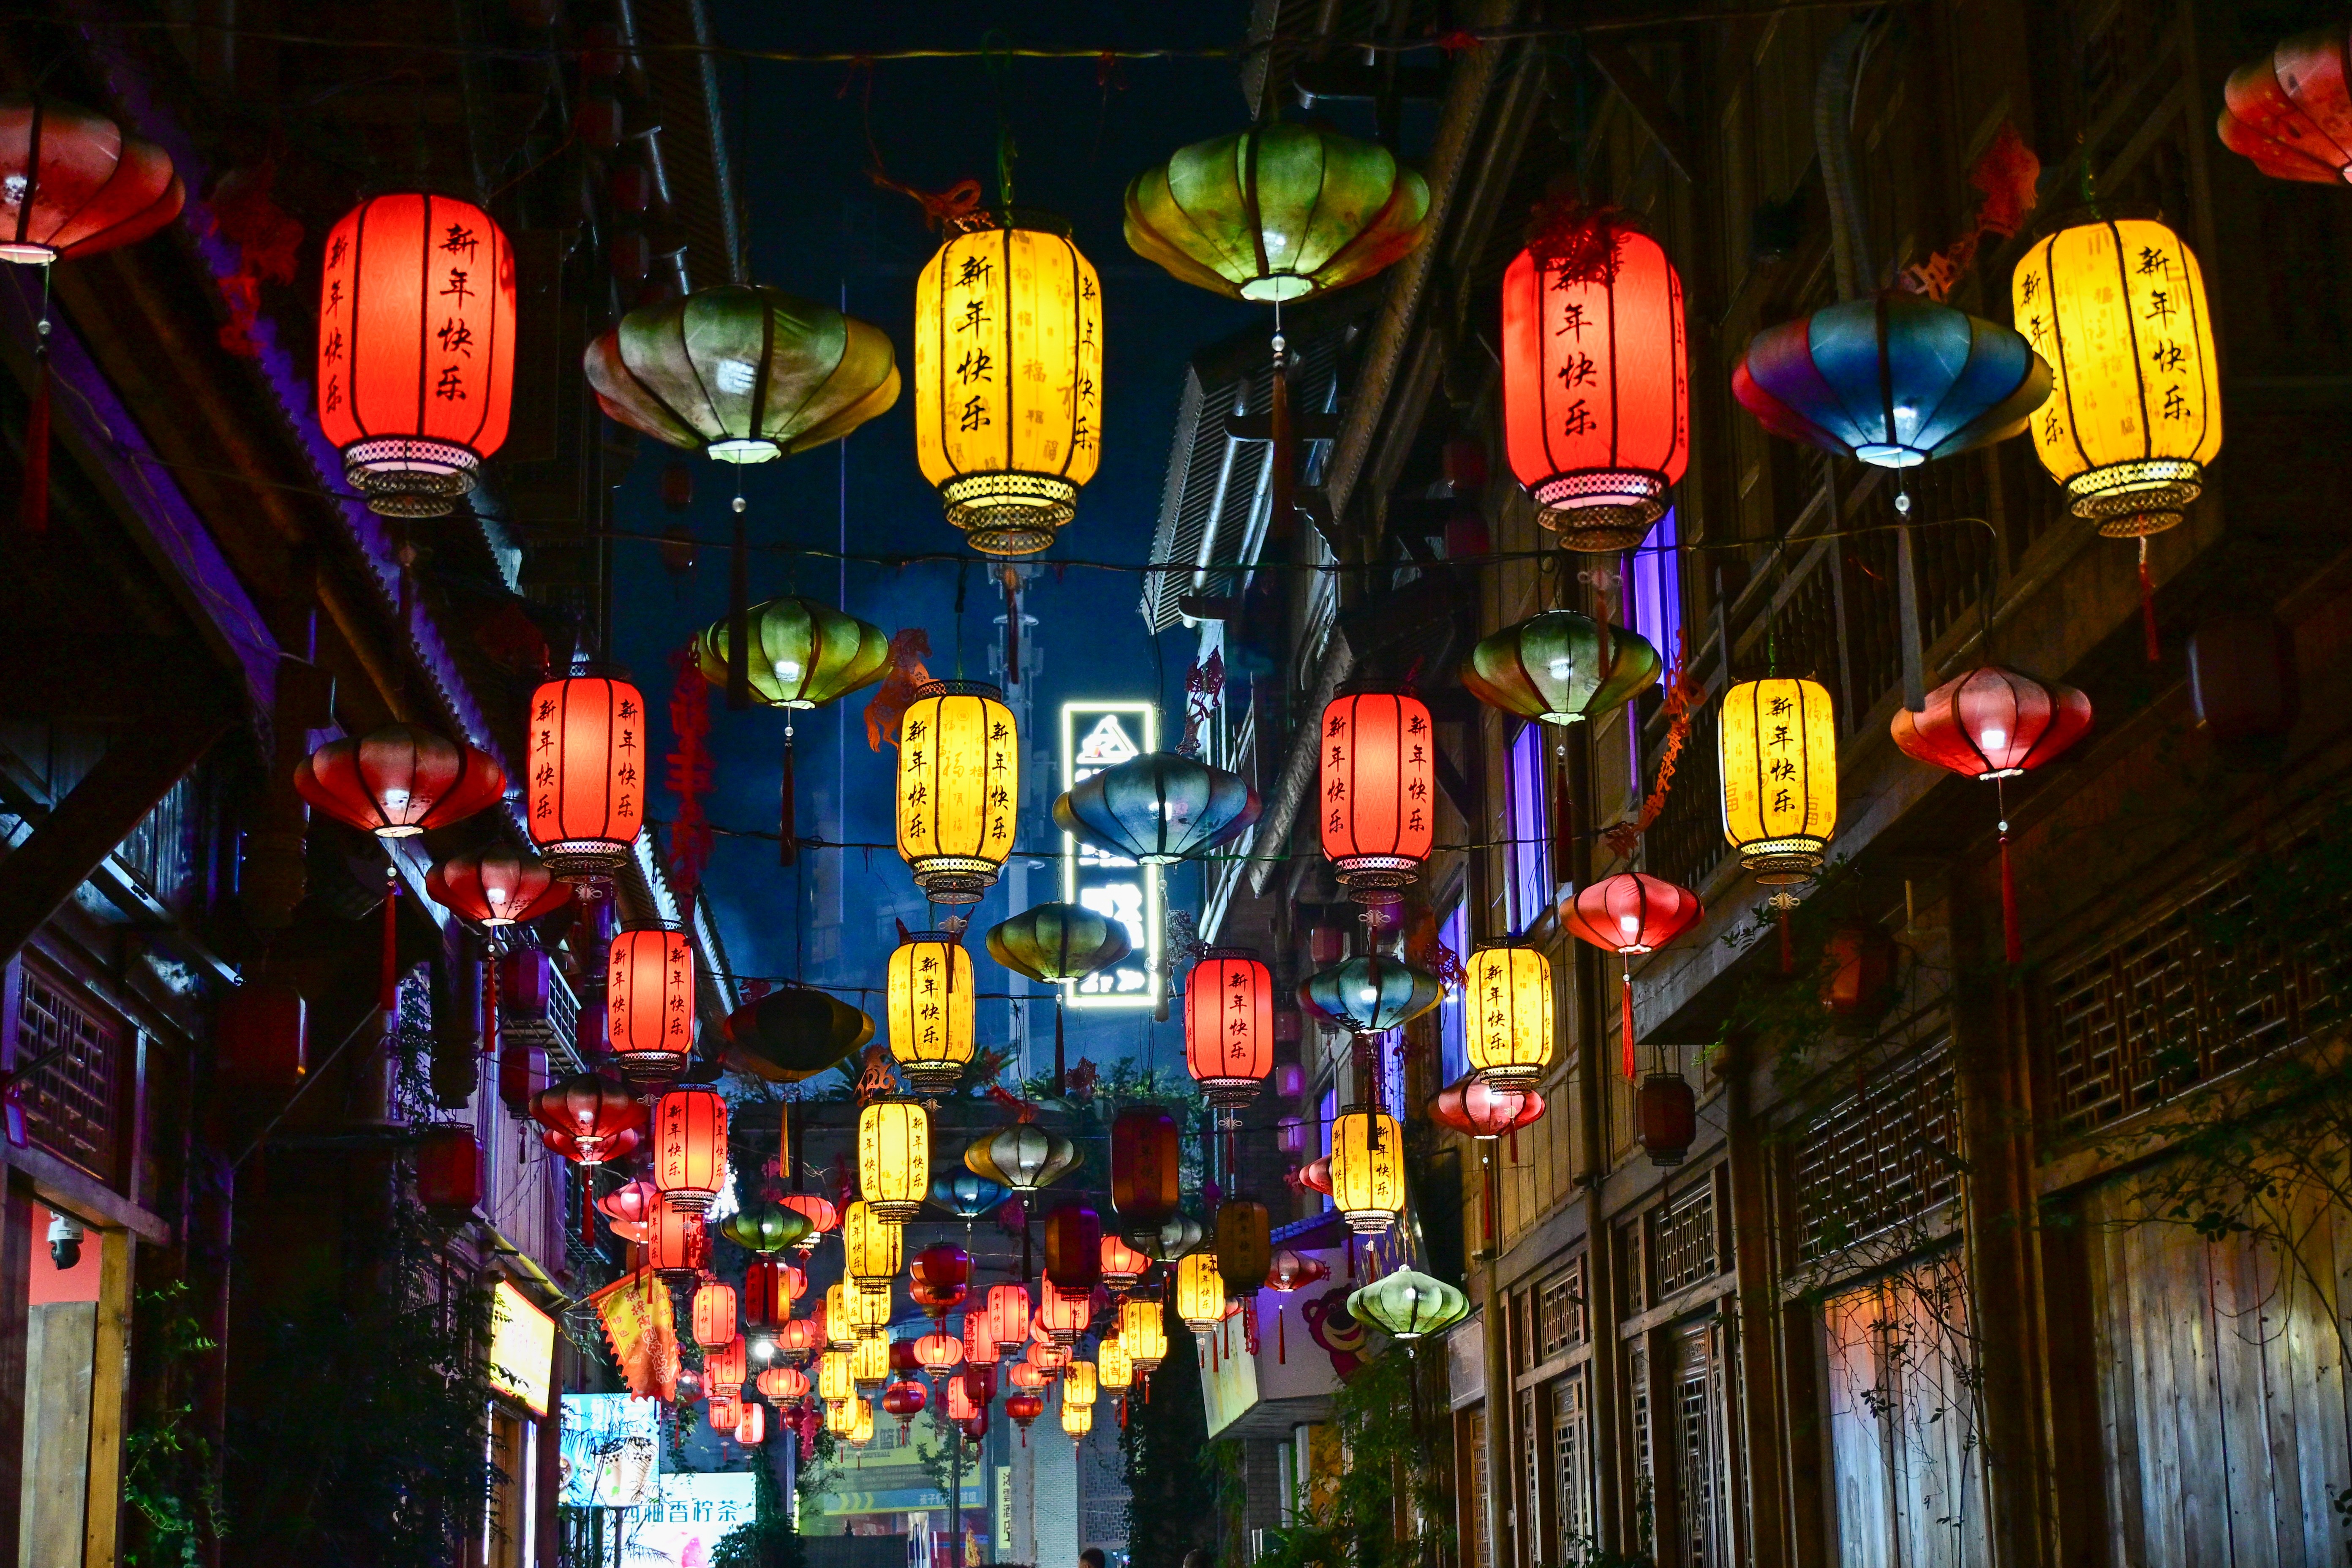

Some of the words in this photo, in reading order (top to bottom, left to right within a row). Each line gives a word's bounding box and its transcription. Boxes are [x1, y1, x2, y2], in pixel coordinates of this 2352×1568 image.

[324, 236, 348, 414] 新年快乐
[436, 223, 479, 401] 新年快乐
[954, 256, 994, 432] 新年快乐
[2137, 246, 2191, 421] 新年快乐
[1075, 276, 1097, 450] 新年快乐
[2020, 270, 2064, 446] 新年乐
[536, 700, 557, 819] 新年快乐
[617, 699, 638, 818] 新年快乐
[905, 720, 927, 839] 新年快乐
[989, 721, 1009, 841] 新年快乐
[1326, 716, 1347, 834] 新年快乐
[1407, 714, 1428, 833] 新年快乐
[1765, 697, 1796, 813] 新年快乐
[612, 949, 627, 1037] 新年快乐
[669, 947, 686, 1035] 新年快乐
[918, 956, 940, 1045] 新年快乐
[1228, 972, 1248, 1059] 新年快乐
[1484, 965, 1505, 1050] 新年快乐
[667, 1104, 683, 1176] 新年快乐
[716, 1106, 724, 1178] 新年快乐
[863, 1119, 876, 1191] 新年快乐
[912, 1116, 924, 1188] 新年快乐
[1333, 1130, 1343, 1200] 新年快乐
[1376, 1125, 1390, 1196] 新年快乐
[650, 1203, 659, 1260] 新年快乐
[851, 1212, 863, 1269] 新年快乐
[700, 1294, 710, 1335] 新年快乐
[835, 1291, 844, 1333] 新年快乐
[993, 1292, 1001, 1334] 新年快乐
[1200, 1262, 1211, 1309] 新年快乐
[1129, 1311, 1138, 1352] 新年快乐
